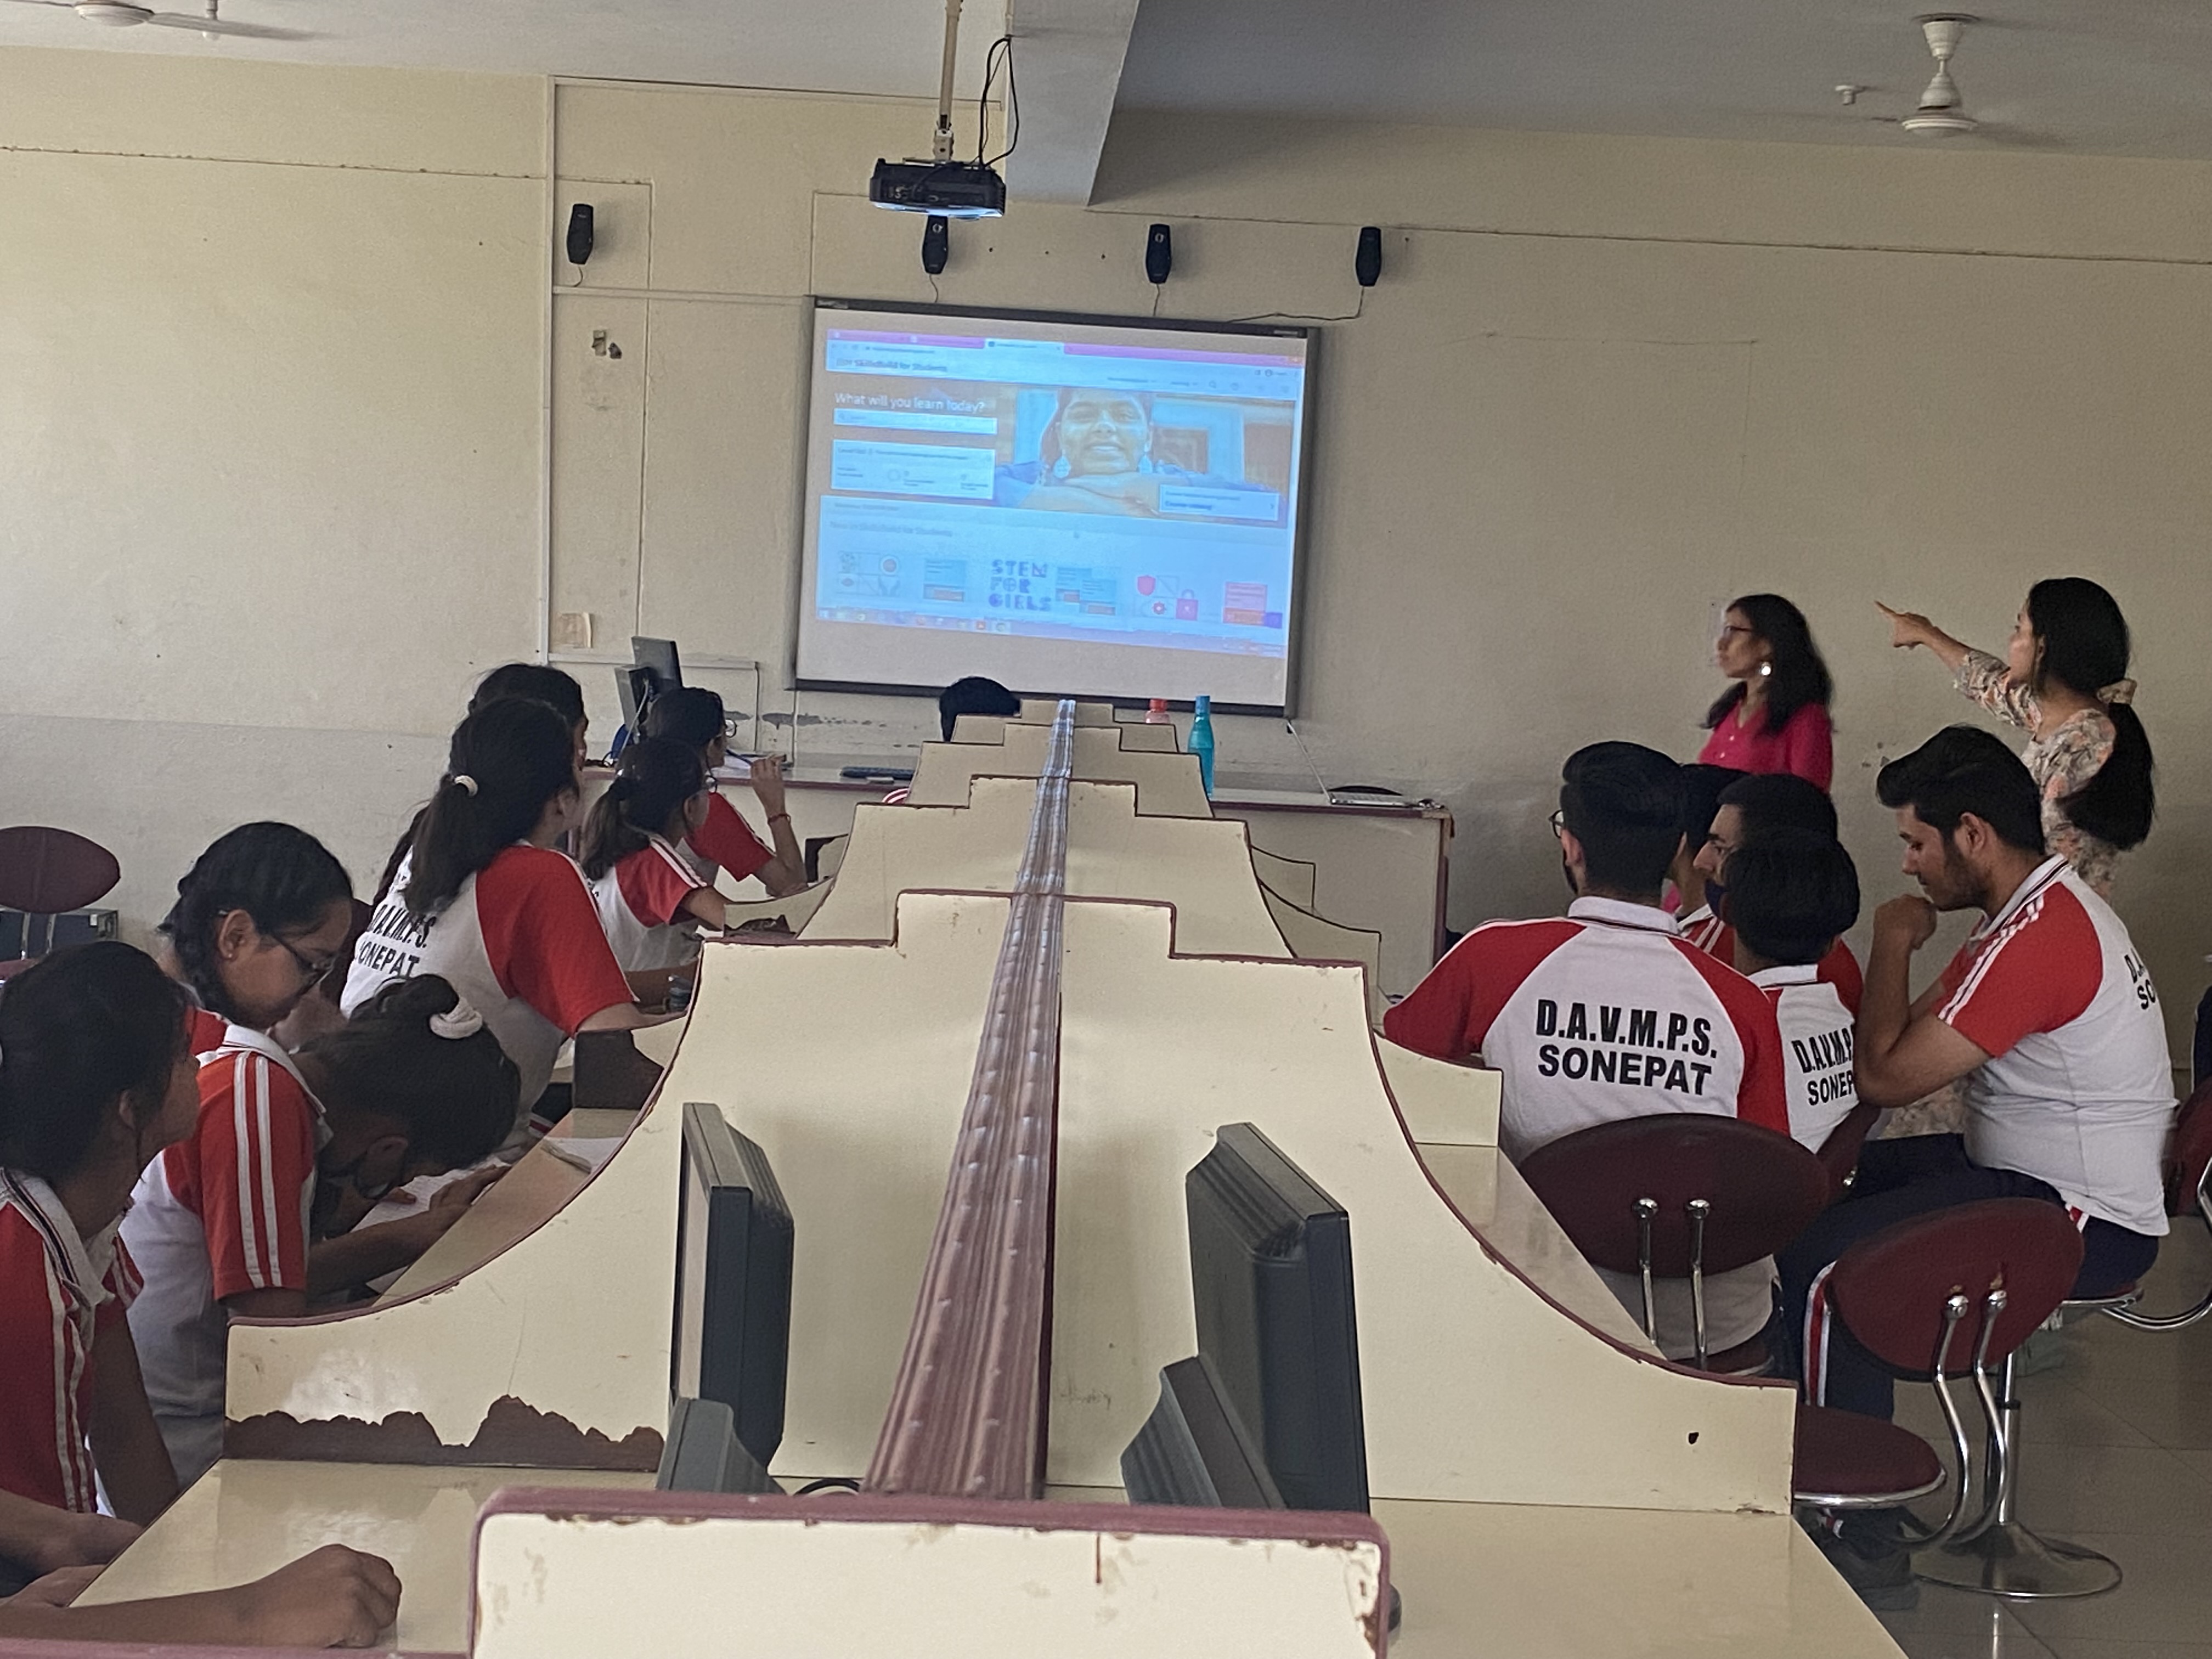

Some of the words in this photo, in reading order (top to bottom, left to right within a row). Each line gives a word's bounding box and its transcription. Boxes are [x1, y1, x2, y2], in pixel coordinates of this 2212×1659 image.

[834, 393, 865, 405] What
[867, 394, 888, 407] will
[890, 398, 911, 409] you
[913, 397, 944, 410] learn
[946, 400, 985, 413] today?
[992, 560, 1048, 578] STEM
[990, 577, 1030, 594] FOR
[989, 593, 1052, 611] GIRLS
[1536, 999, 1718, 1059] D.A.V.M.P.S.
[1538, 1045, 1712, 1096] SONEPAT
[1807, 1070, 1854, 1106] SONEP
